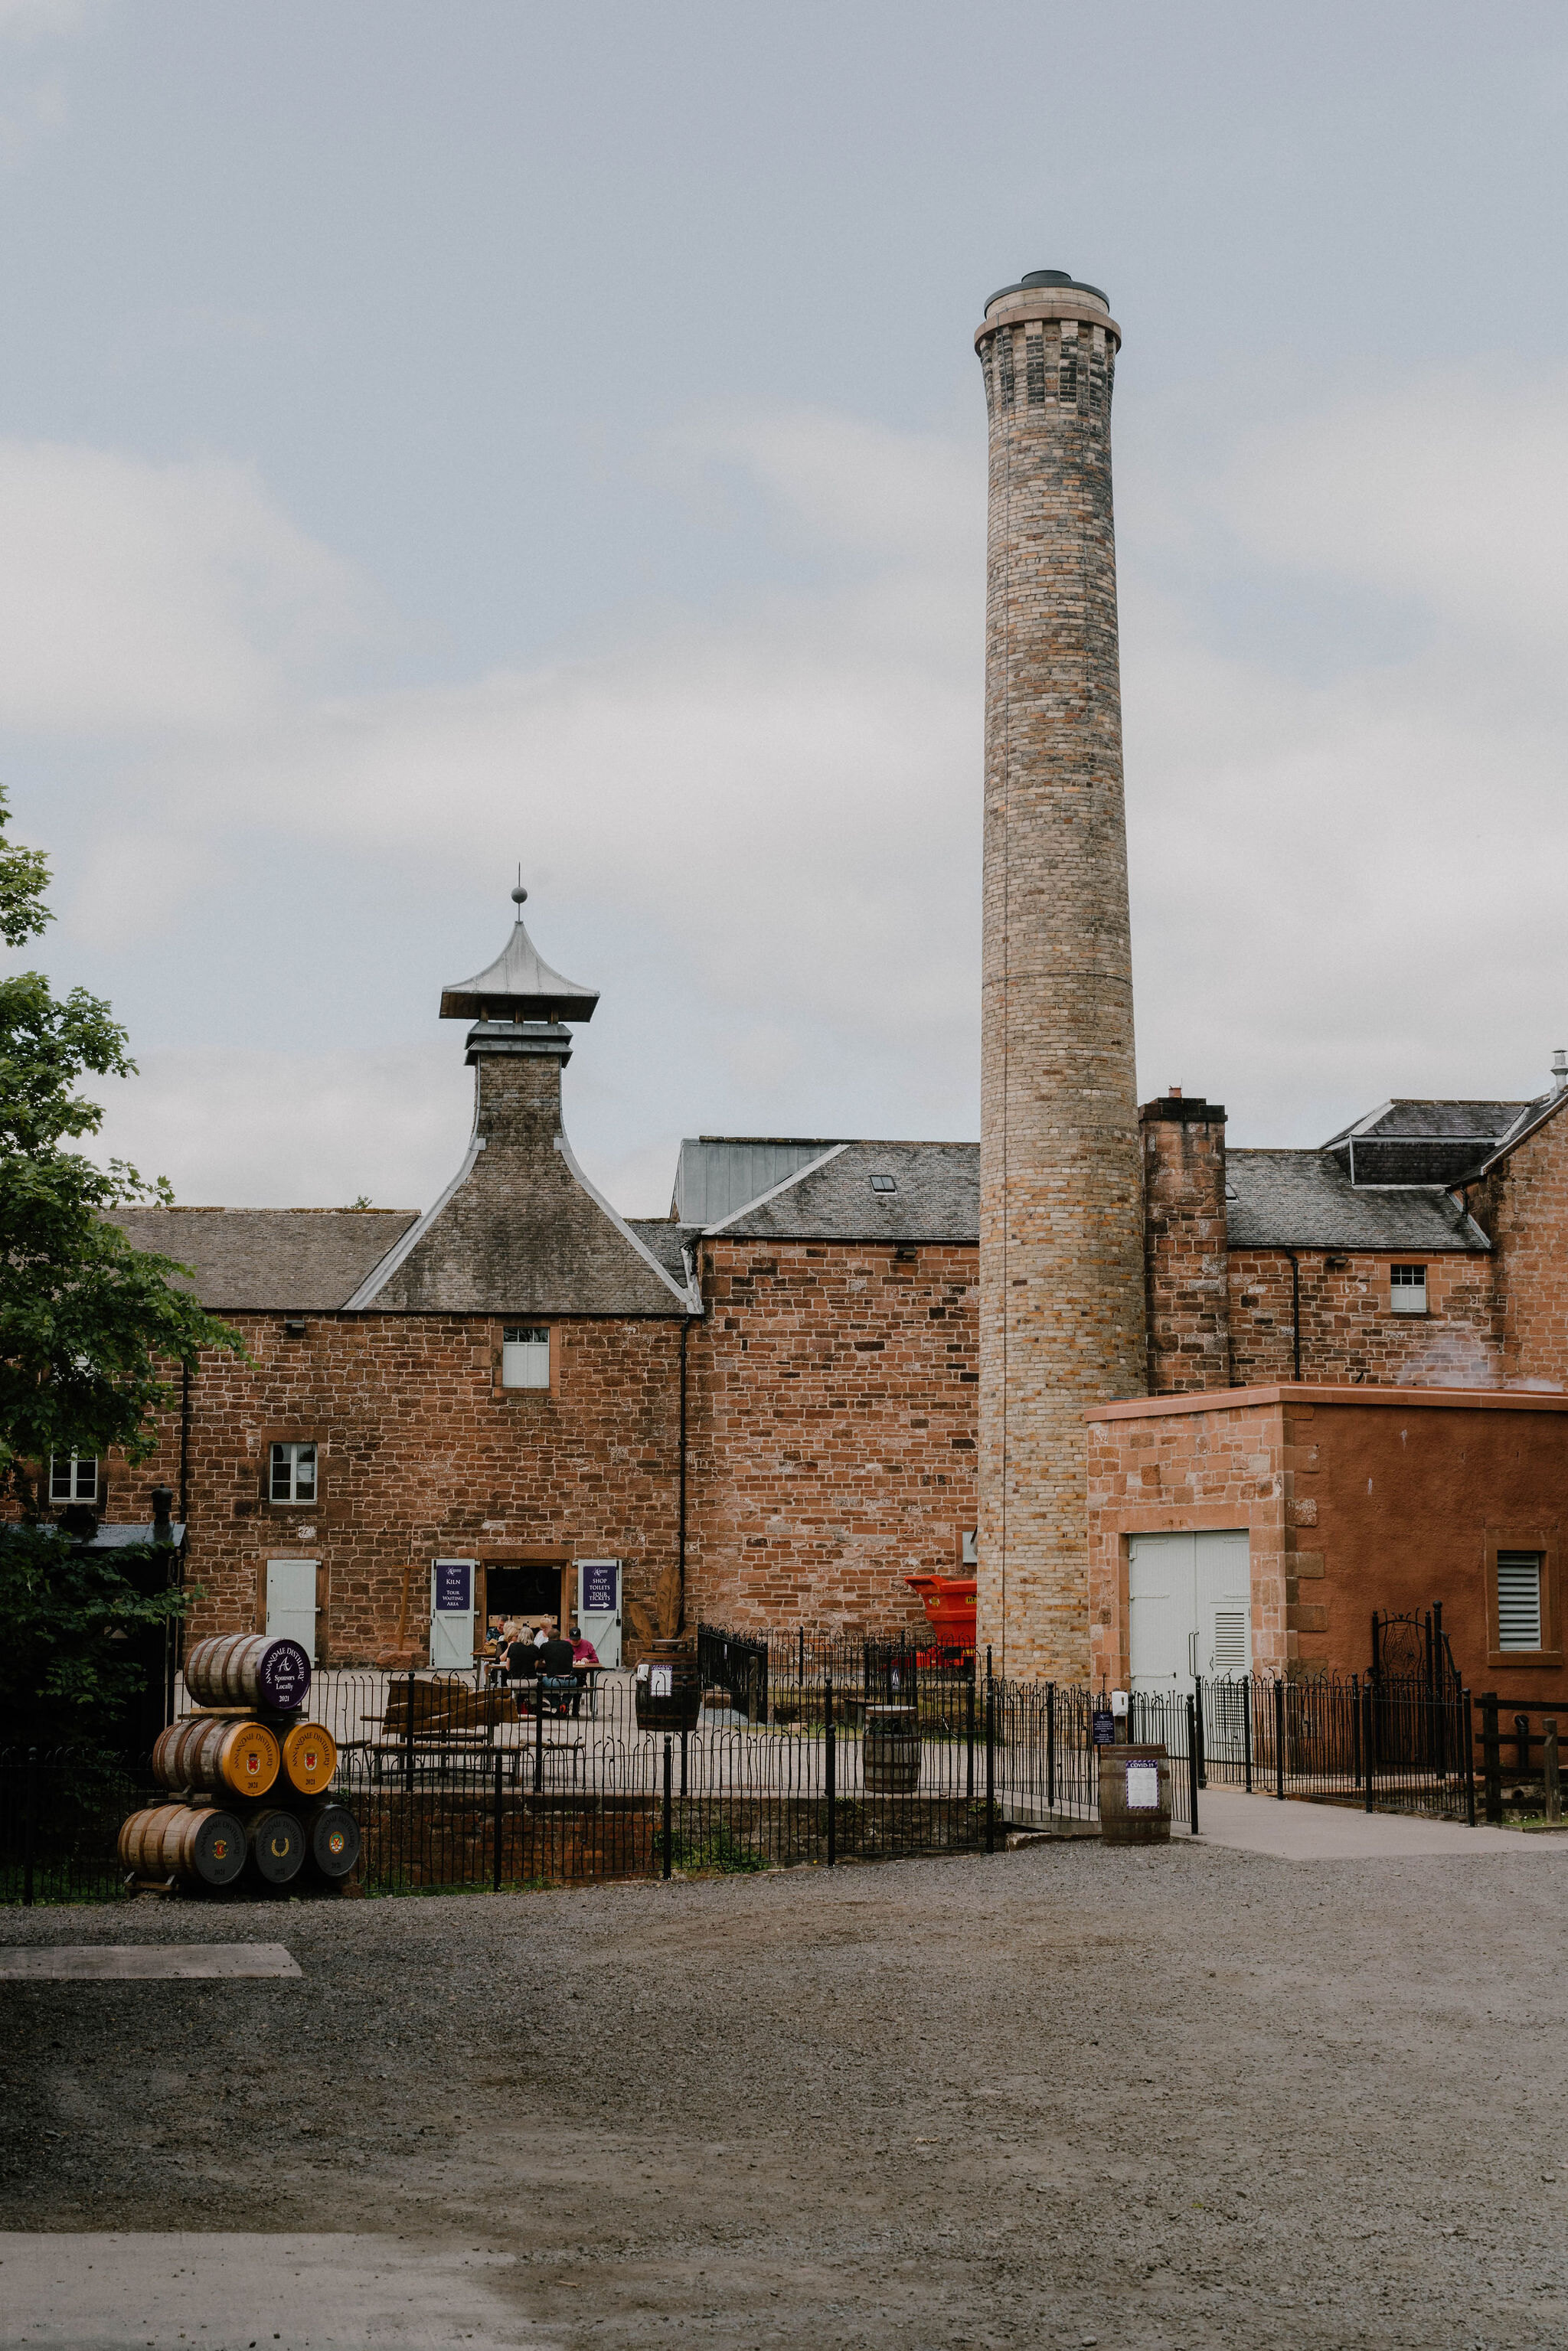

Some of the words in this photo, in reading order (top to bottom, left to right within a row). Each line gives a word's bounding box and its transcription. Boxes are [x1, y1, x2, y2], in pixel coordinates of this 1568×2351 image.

[265, 1647, 286, 1684] ANNANDALE
[286, 1647, 305, 1682] DISTILLERY
[274, 1674, 295, 1683] Sponsors
[276, 1683, 293, 1691] Locally
[234, 1732, 254, 1770] ANNANDALE
[256, 1732, 273, 1768] DISTILLERY
[292, 1732, 313, 1767] ANNANDALE
[313, 1732, 330, 1768] DISTILLERY
